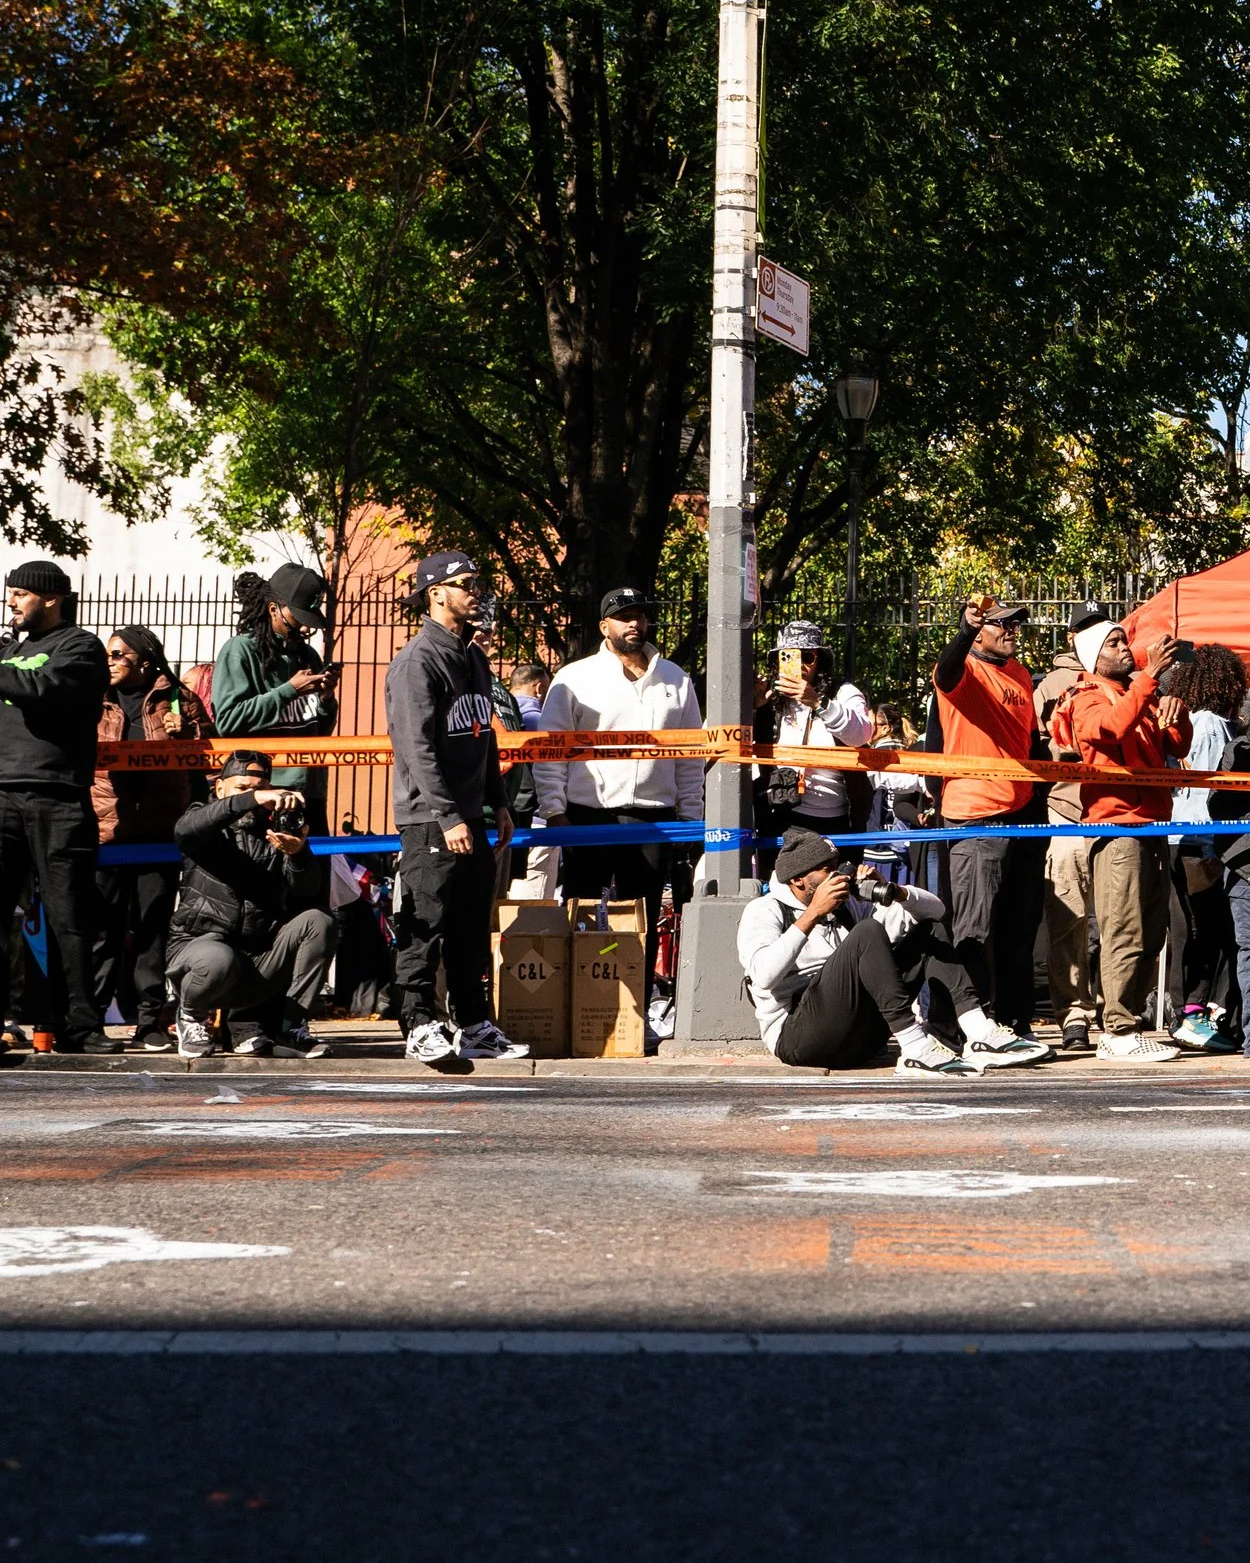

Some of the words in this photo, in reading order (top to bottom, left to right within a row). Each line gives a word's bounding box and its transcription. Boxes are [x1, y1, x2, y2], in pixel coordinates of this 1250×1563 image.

[777, 288, 794, 305] Thursday
[128, 754, 169, 767] NEW
[174, 753, 224, 766] YORK
[286, 752, 326, 764] NEW
[332, 752, 380, 763] YORK
[499, 748, 534, 760] ORK
[593, 748, 632, 758] NEW
[518, 963, 546, 980] C&L
[592, 962, 620, 980] C&L
